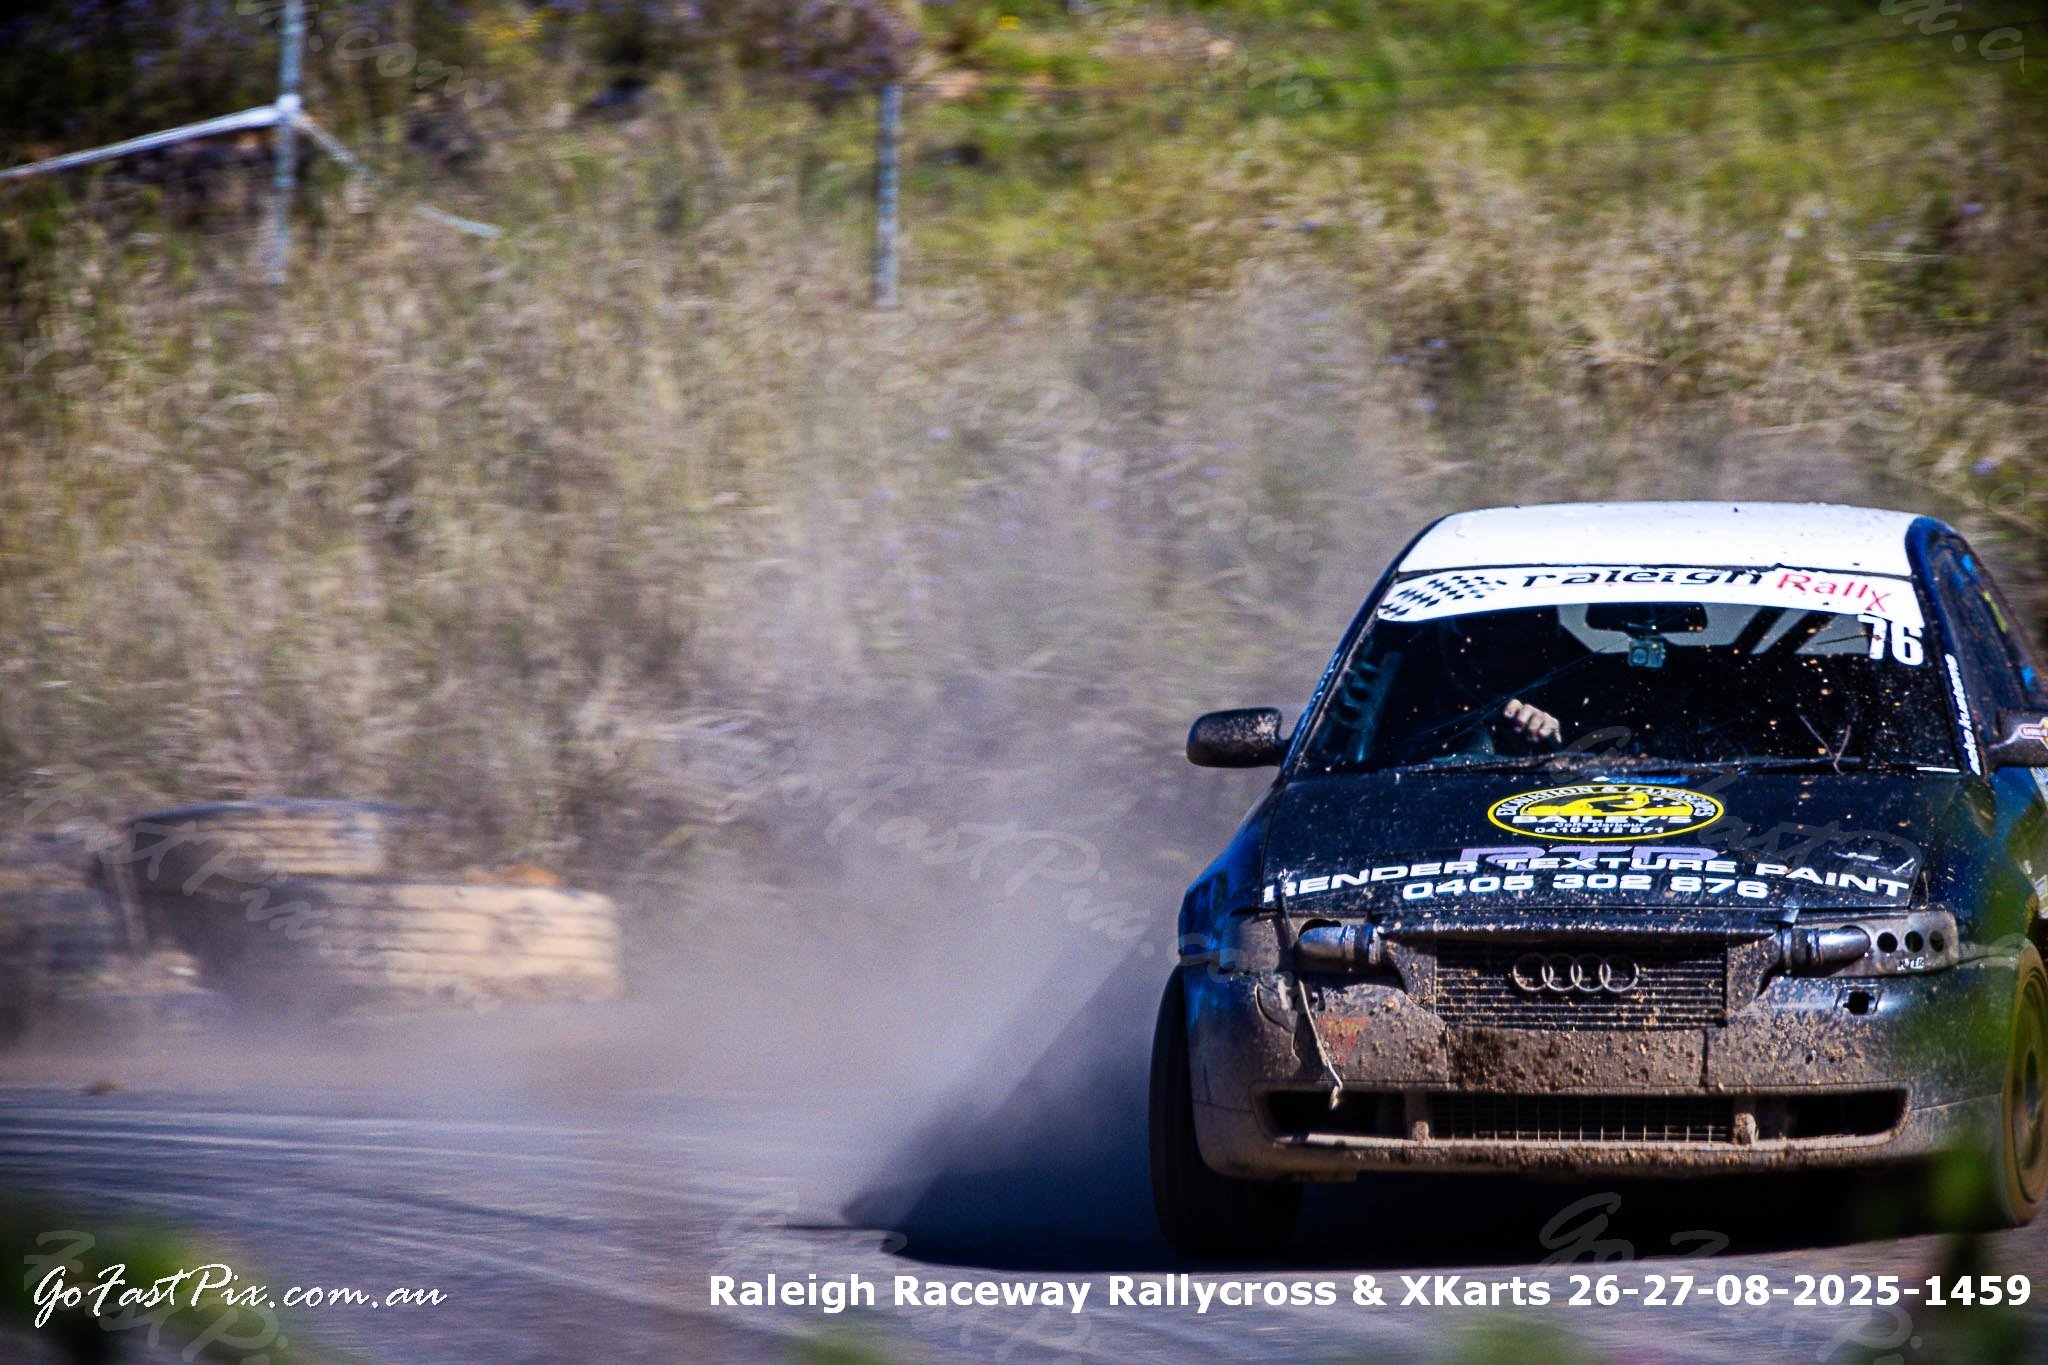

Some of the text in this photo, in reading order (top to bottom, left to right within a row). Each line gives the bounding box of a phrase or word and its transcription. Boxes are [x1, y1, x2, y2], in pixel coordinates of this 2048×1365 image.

[1521, 568, 1762, 588] raleigh
[1857, 614, 1925, 666] 76
[1511, 815, 1692, 824] BAILEY'S
[1263, 856, 1910, 903] RENDER TEXTURE PAINT
[1402, 873, 1769, 901] 0405 302 876
